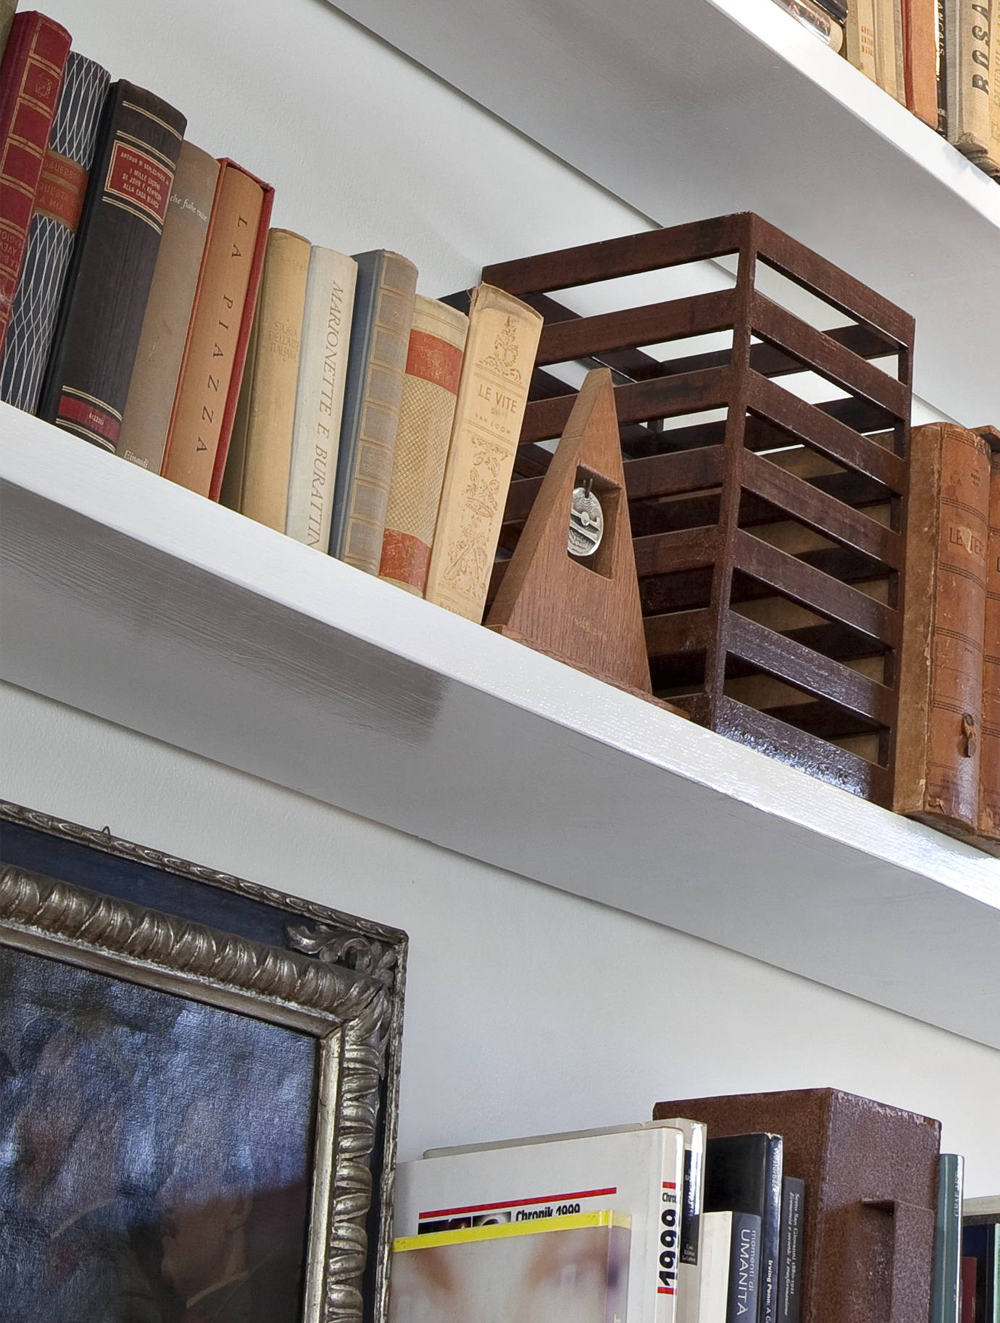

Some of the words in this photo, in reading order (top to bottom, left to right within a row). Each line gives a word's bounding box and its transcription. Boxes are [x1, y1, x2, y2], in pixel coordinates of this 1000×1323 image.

[120, 151, 138, 164] ARTHUR
[129, 176, 141, 188] JOHN
[133, 169, 148, 182] MILLE
[122, 183, 134, 193] ALLA
[135, 189, 147, 200] CASA
[146, 195, 160, 209] BIANCA
[231, 215, 248, 259] LA
[326, 279, 345, 417] MARIONETTE
[195, 293, 234, 454] PIAZZA
[477, 383, 492, 402] LE
[495, 389, 518, 415] VITE
[318, 424, 331, 440] E
[123, 449, 149, 469] Einaudi
[515, 1206, 553, 1222] Chronik
[658, 1208, 679, 1288] 1999
[736, 1228, 751, 1316] UMANITÀ
[749, 1279, 755, 1292] di
